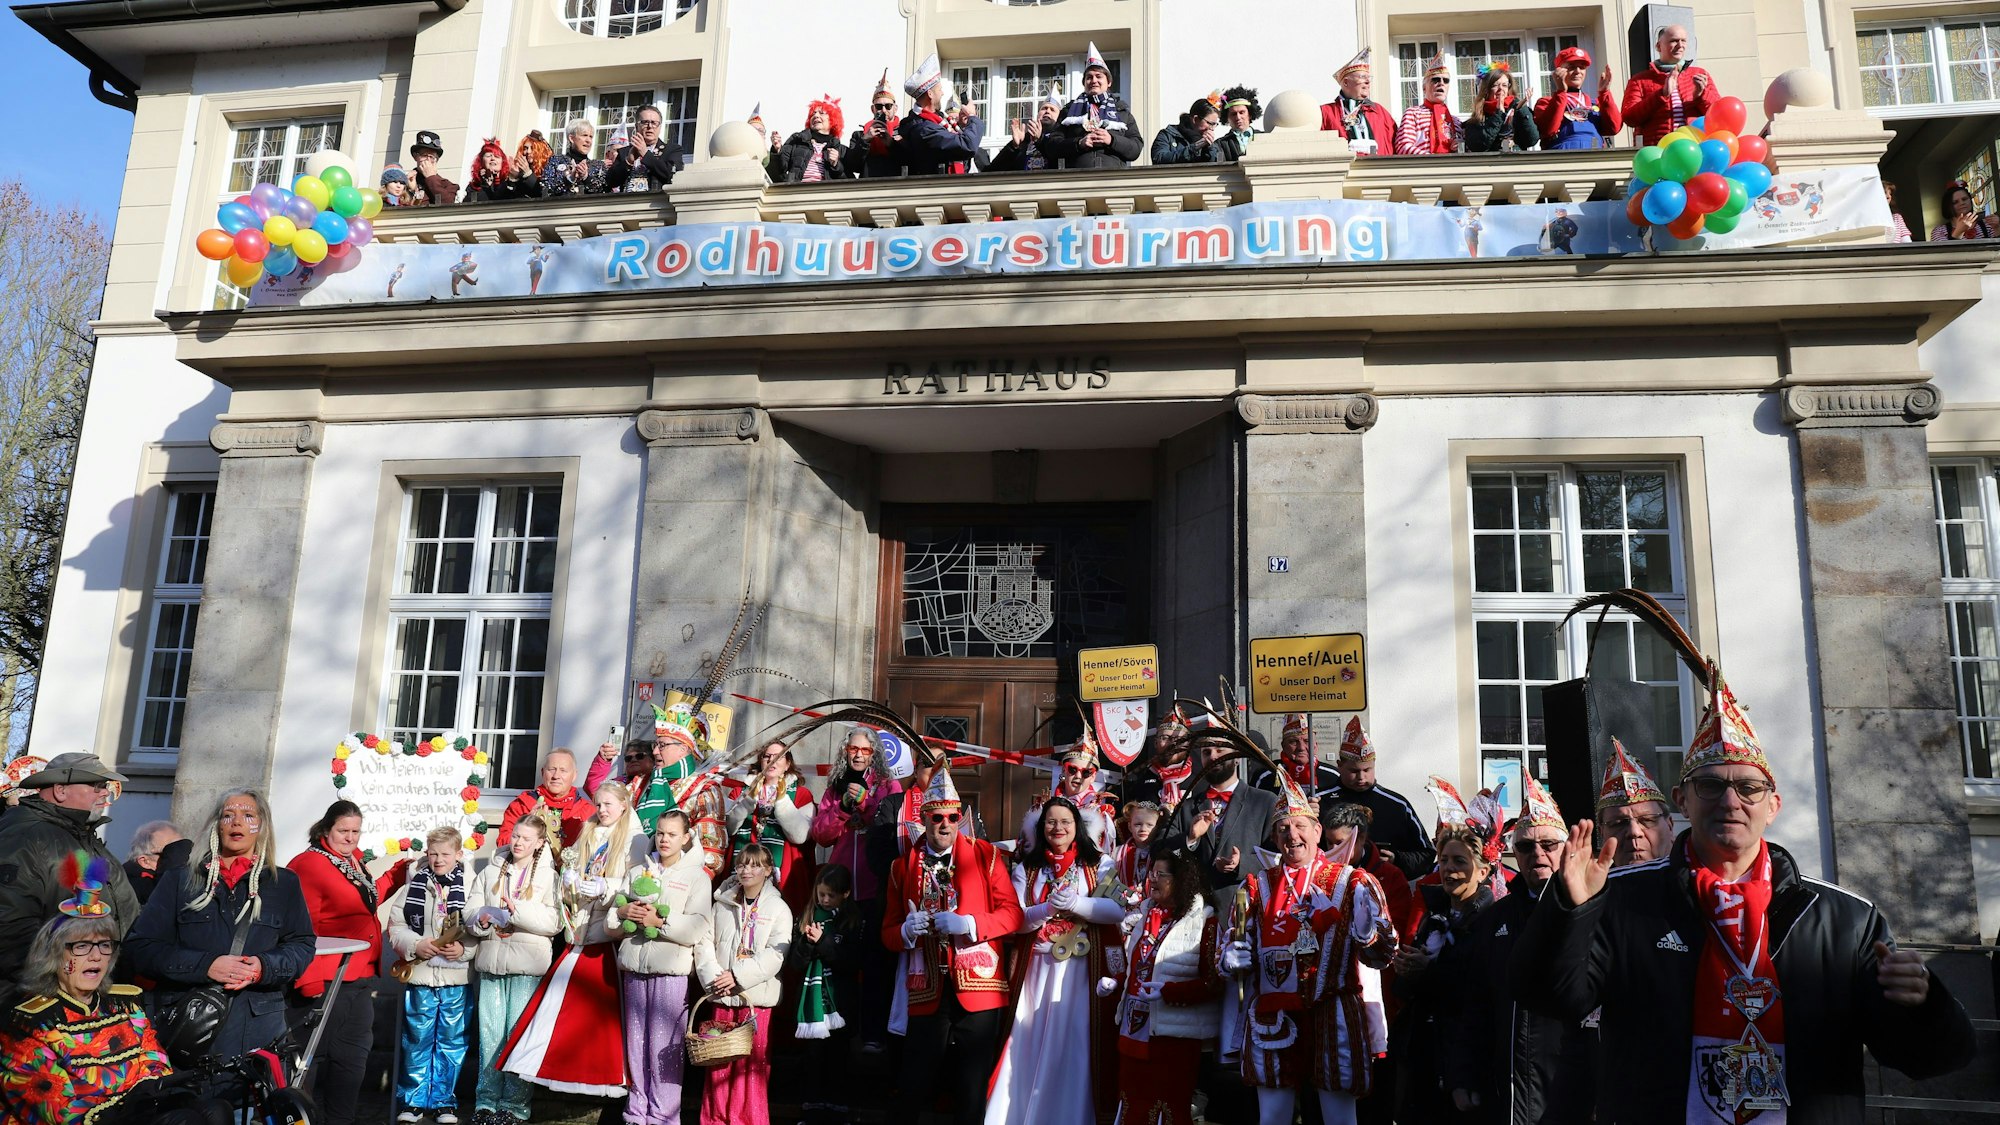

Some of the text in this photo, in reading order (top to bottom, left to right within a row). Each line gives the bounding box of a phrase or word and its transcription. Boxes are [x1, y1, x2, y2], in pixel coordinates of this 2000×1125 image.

[605, 210, 1391, 283] Rodhuuserstürmung
[882, 356, 1112, 395] RATHAUS
[1271, 557, 1287, 571] 97
[1083, 657, 1153, 670] Hennef/Söven
[1256, 649, 1359, 668] Hennef/Auel
[1099, 673, 1138, 682] Unser Dorf
[1279, 675, 1336, 686] Unser Dorf
[1093, 683, 1146, 693] Unsere Heimat
[1270, 690, 1347, 702] Unsere Heimat
[1105, 707, 1121, 715] SKC
[359, 755, 386, 774] Wir
[429, 761, 454, 776] wie
[392, 799, 434, 817] zeigen
[437, 801, 458, 814] wir
[1656, 940, 1689, 952] adidas
